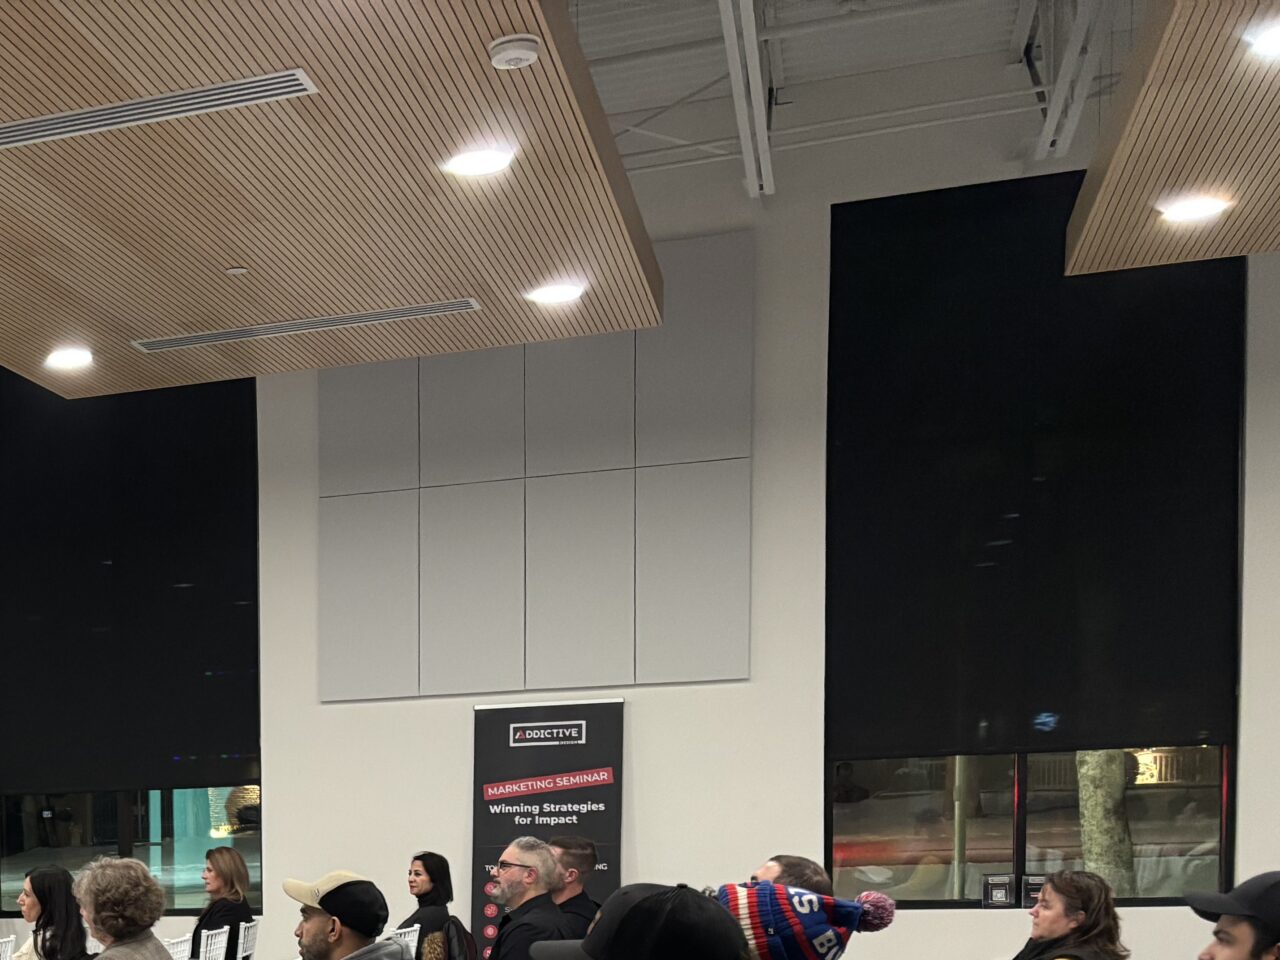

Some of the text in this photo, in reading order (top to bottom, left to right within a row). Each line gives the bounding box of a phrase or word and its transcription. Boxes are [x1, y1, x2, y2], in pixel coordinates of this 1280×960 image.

[514, 728, 579, 739] ADDICTIVE
[488, 771, 608, 796] MARKETING SEMINAR
[489, 801, 606, 814] Winning Strategies
[514, 815, 578, 826] for Impact
